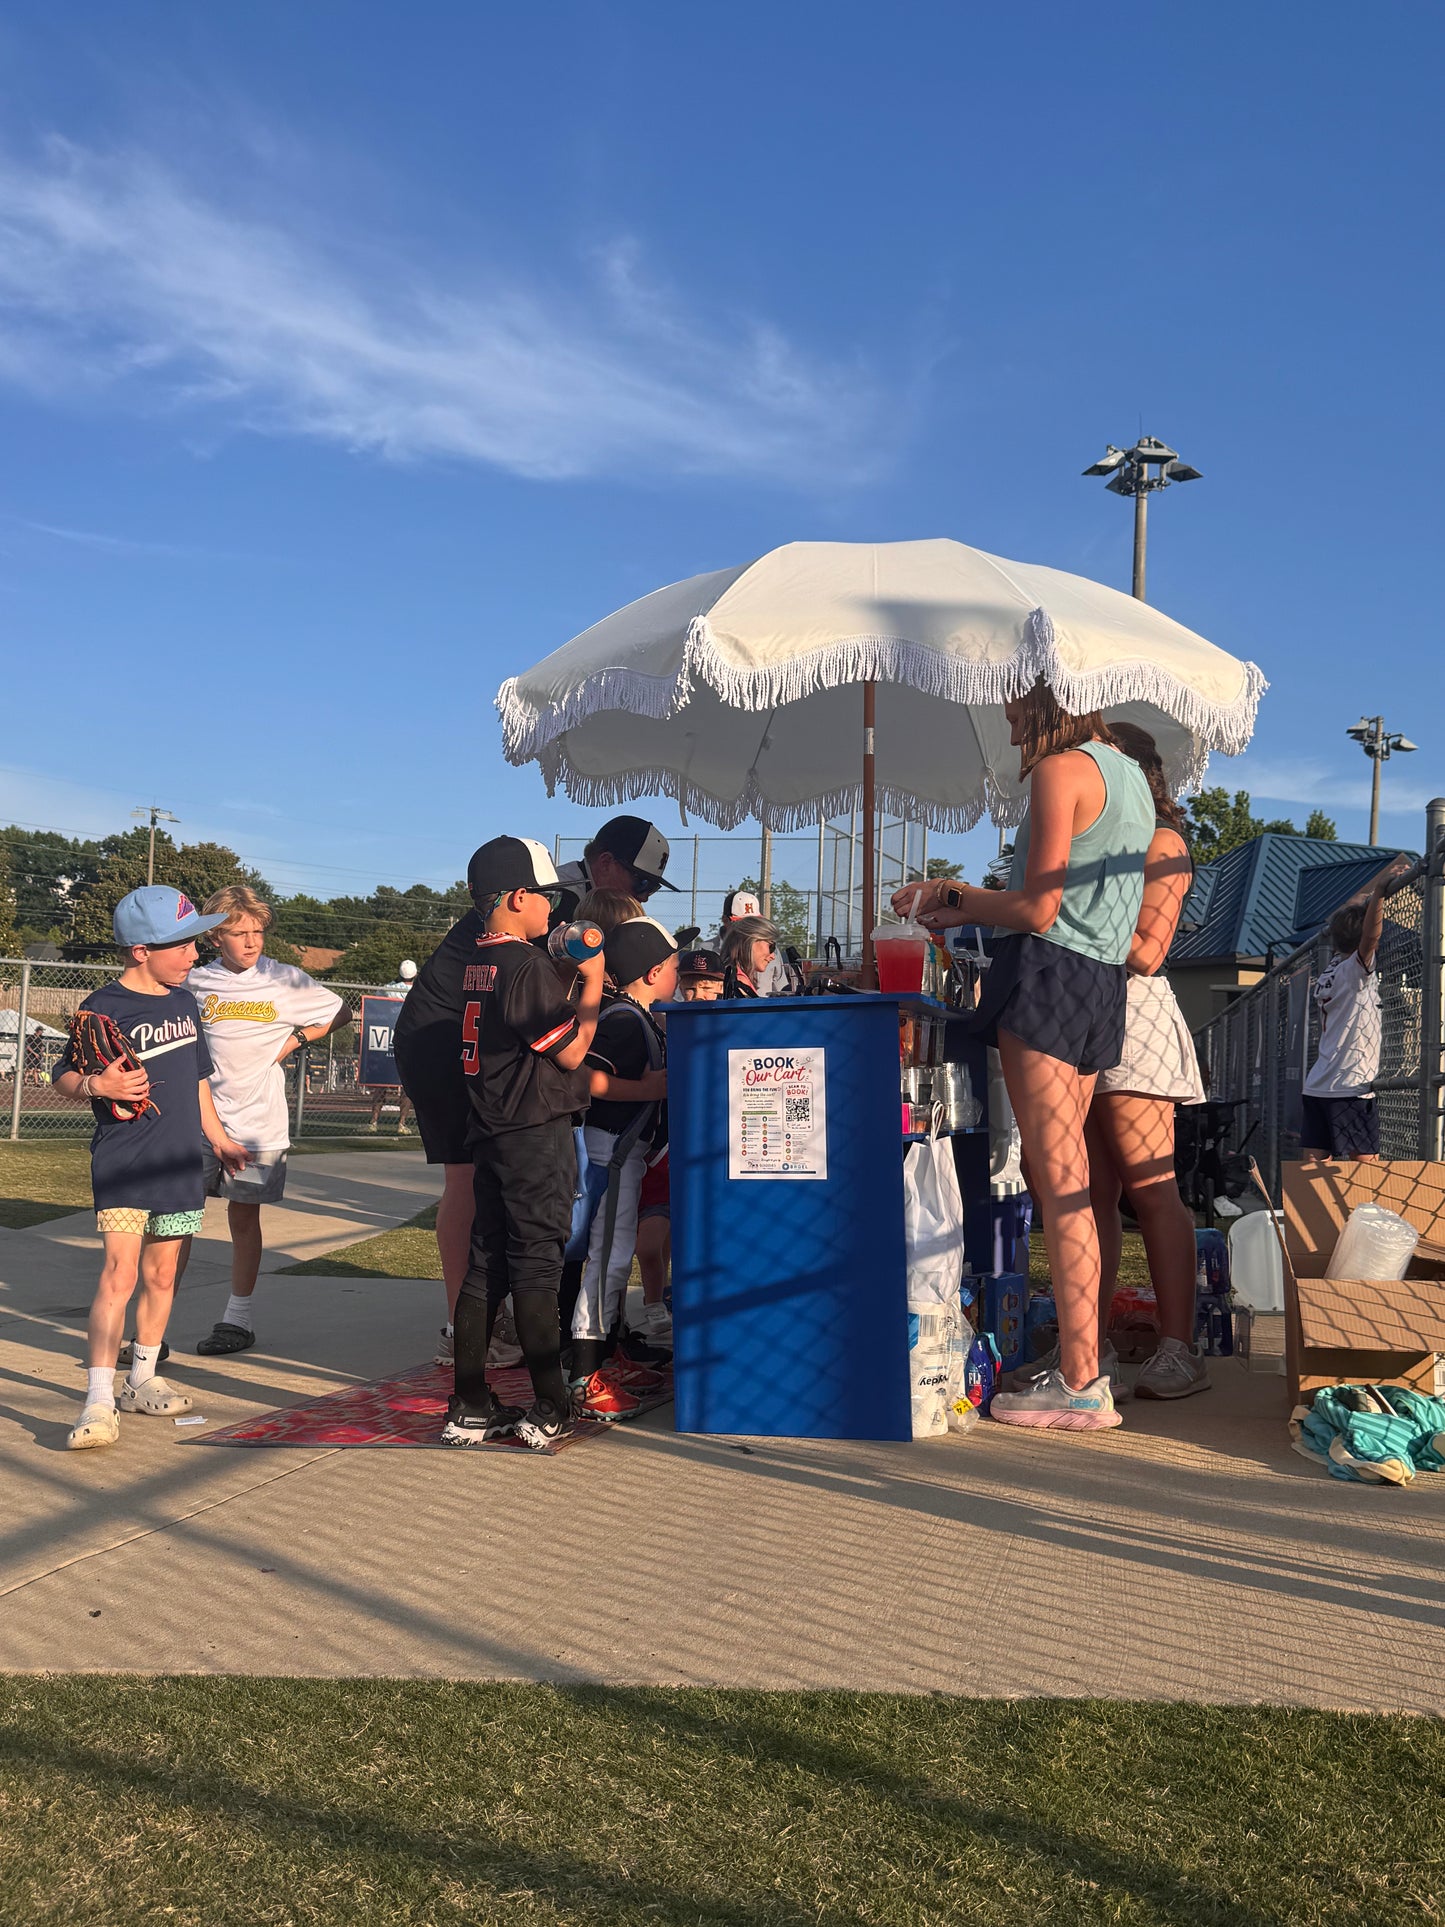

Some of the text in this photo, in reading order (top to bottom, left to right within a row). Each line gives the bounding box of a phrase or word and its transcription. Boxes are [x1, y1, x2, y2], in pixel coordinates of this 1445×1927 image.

[201, 993, 276, 1022] Bananas
[130, 1015, 197, 1051] Patriots
[462, 1001, 481, 1076] 5
[746, 1066, 806, 1086] Our Cart
[753, 1057, 795, 1071] BOOK
[1069, 1398, 1100, 1409] HOKA
